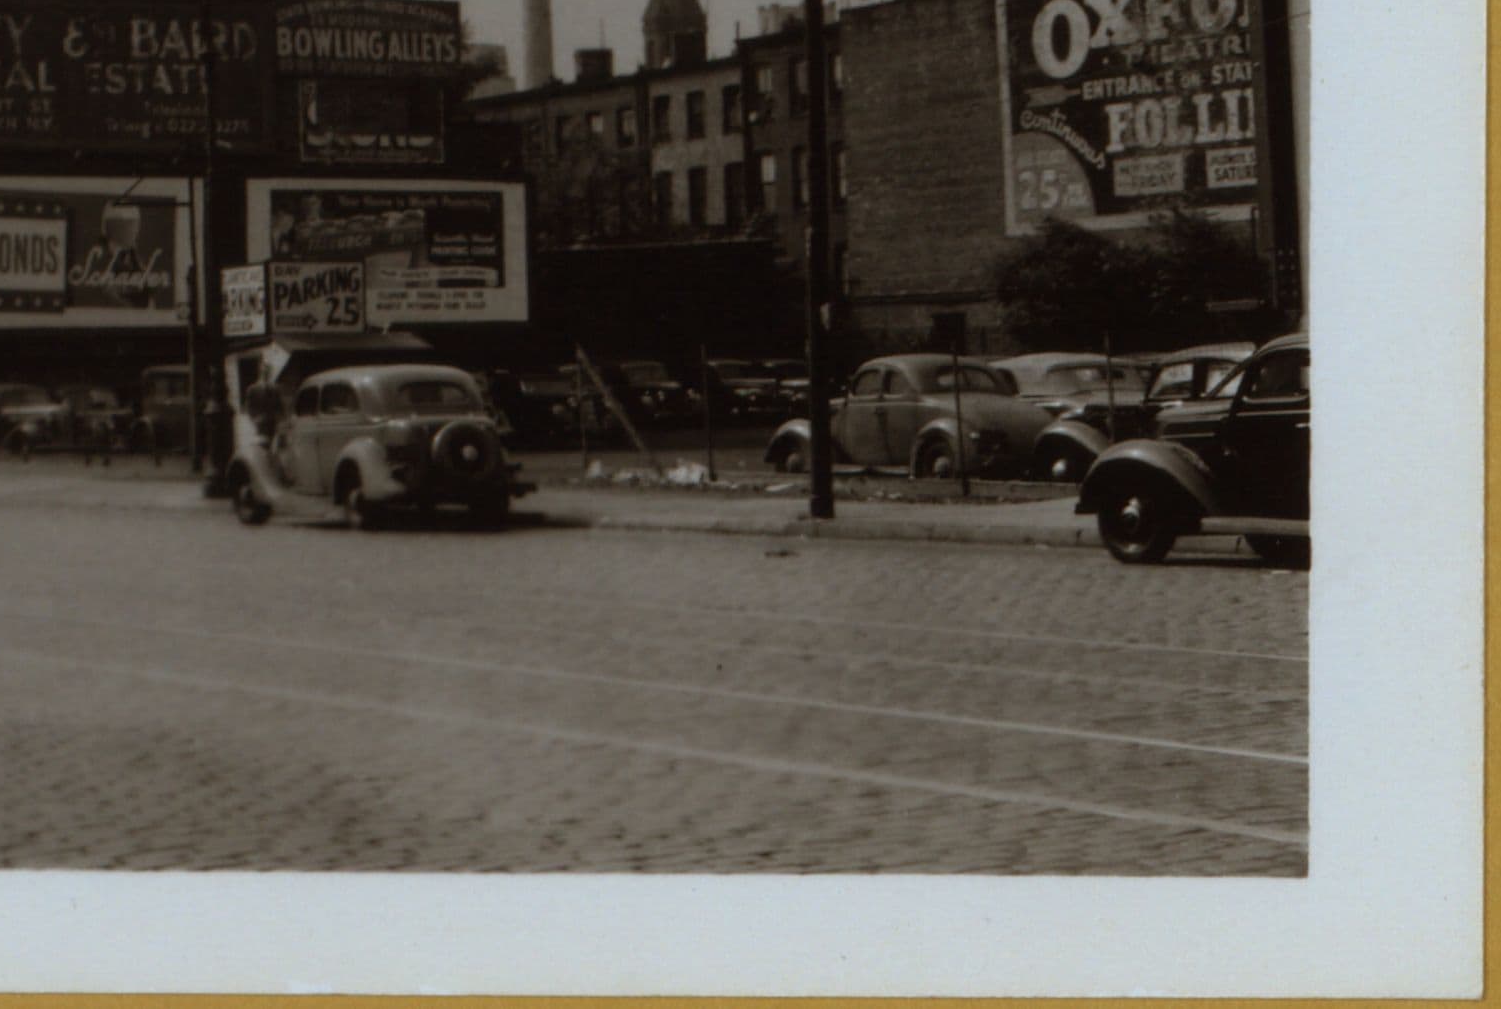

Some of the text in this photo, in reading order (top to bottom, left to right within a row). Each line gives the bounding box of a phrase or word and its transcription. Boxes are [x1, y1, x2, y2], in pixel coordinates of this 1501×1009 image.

[276, 26, 457, 63] BOWLING ALLEYS
[1120, 30, 1252, 69] THEATR
[85, 61, 208, 96] ESTAT
[1082, 68, 1175, 102] ENTRANCE
[1103, 87, 1257, 154] FOLLI
[67, 245, 173, 290] Schaefer
[274, 267, 363, 311] PARKING
[325, 294, 362, 327] 25
